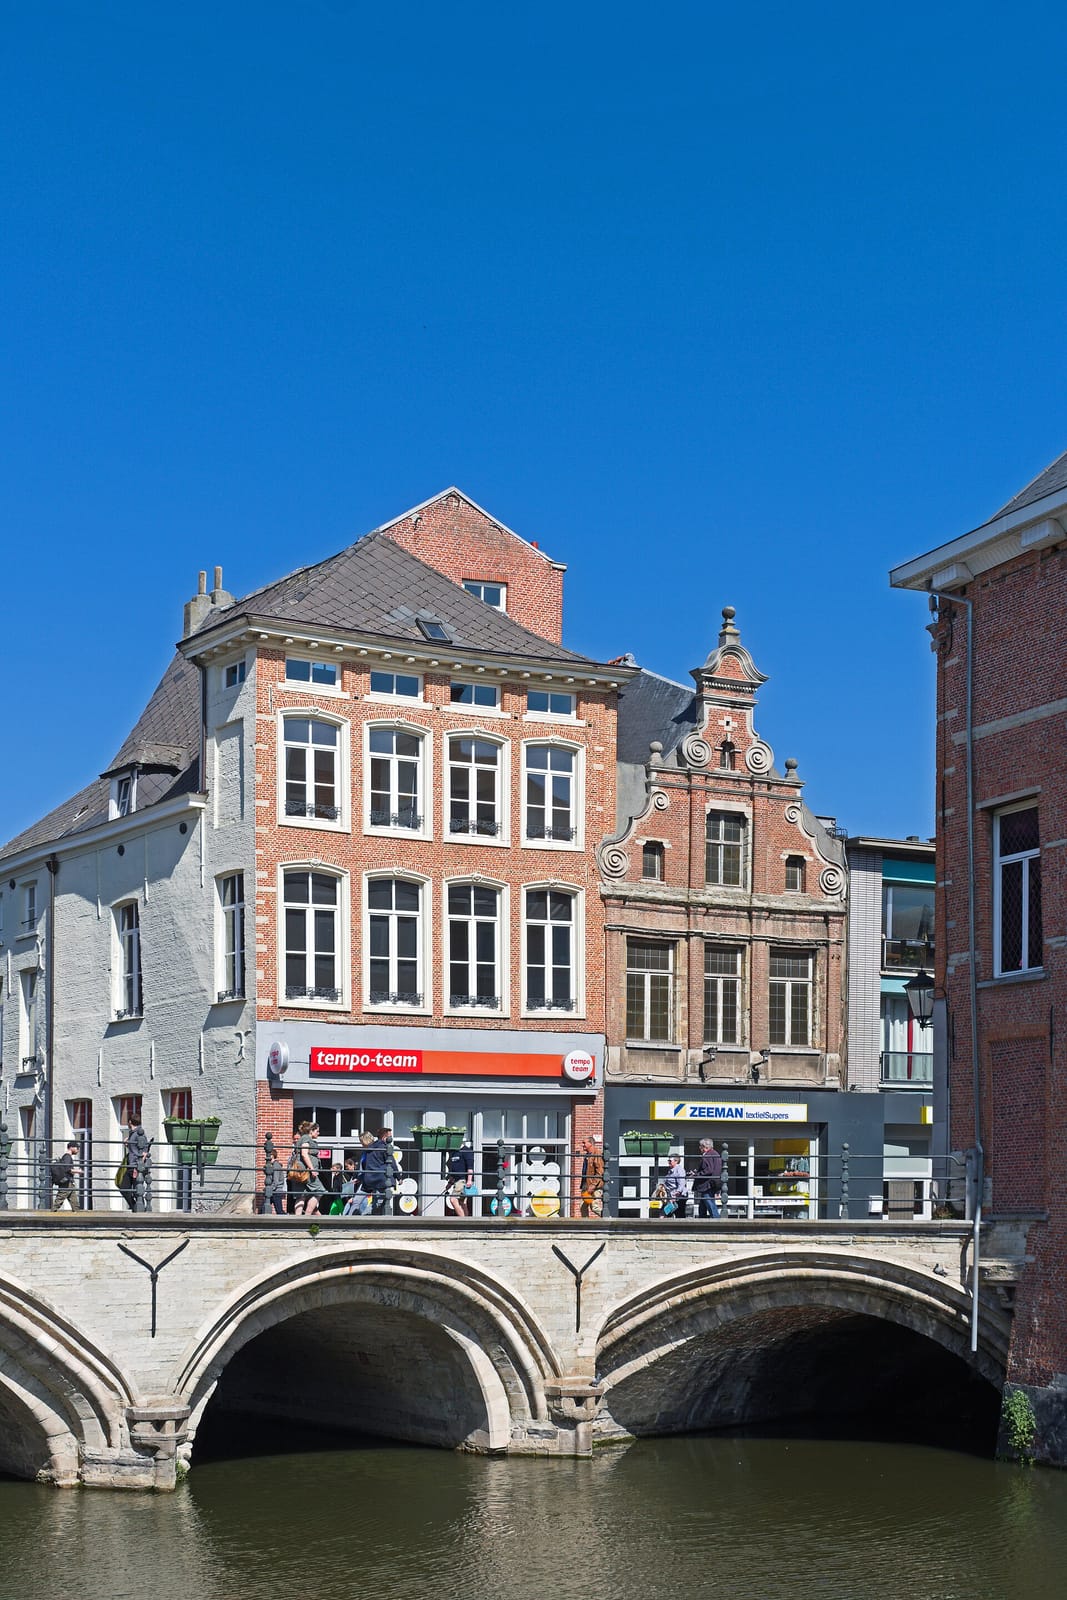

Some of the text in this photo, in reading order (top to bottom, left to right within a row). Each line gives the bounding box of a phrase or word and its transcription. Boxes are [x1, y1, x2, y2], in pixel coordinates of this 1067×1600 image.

[317, 1050, 418, 1071] tempo-team
[570, 1058, 591, 1067] tempo
[689, 1106, 789, 1120] ZEEMAN textielSupers
